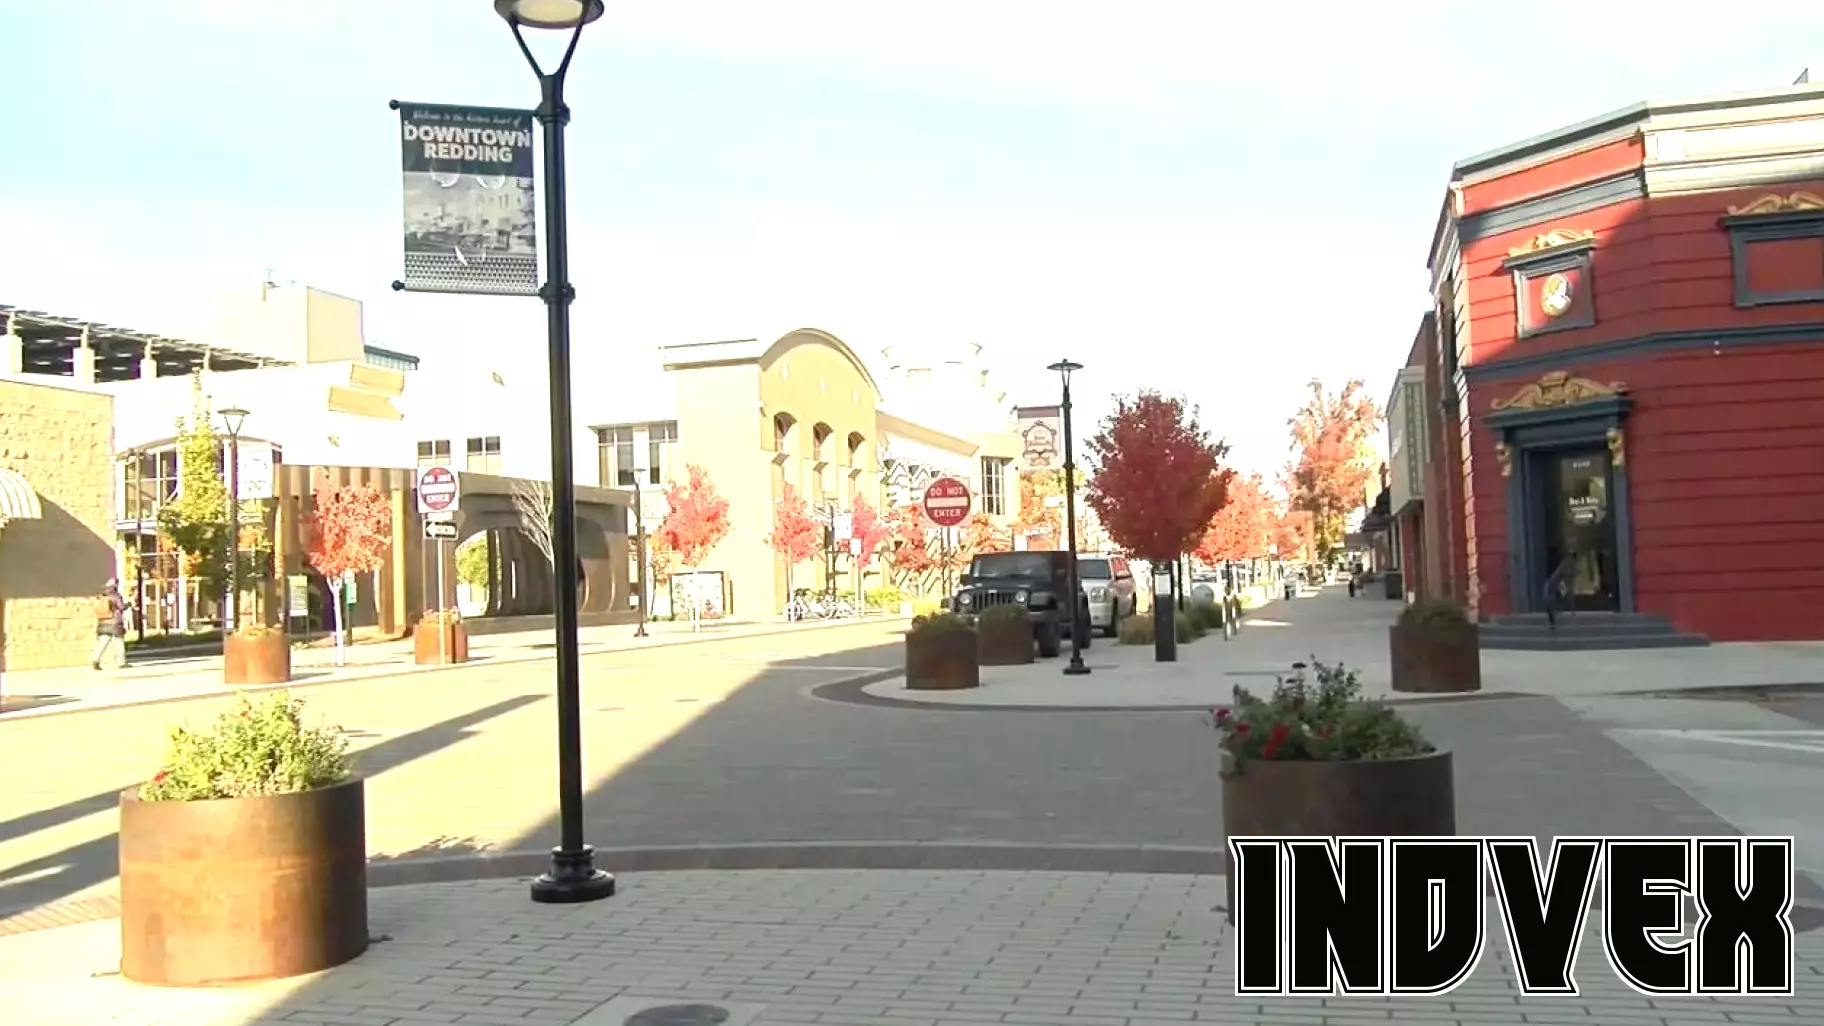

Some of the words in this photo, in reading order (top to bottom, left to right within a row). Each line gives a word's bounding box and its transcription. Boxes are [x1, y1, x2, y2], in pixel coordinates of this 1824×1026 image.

[404, 123, 531, 147] DOWNTOWN
[424, 142, 513, 163] REDDING
[930, 487, 942, 497] DO
[946, 486, 964, 496] NOT
[934, 508, 961, 518] ENTER
